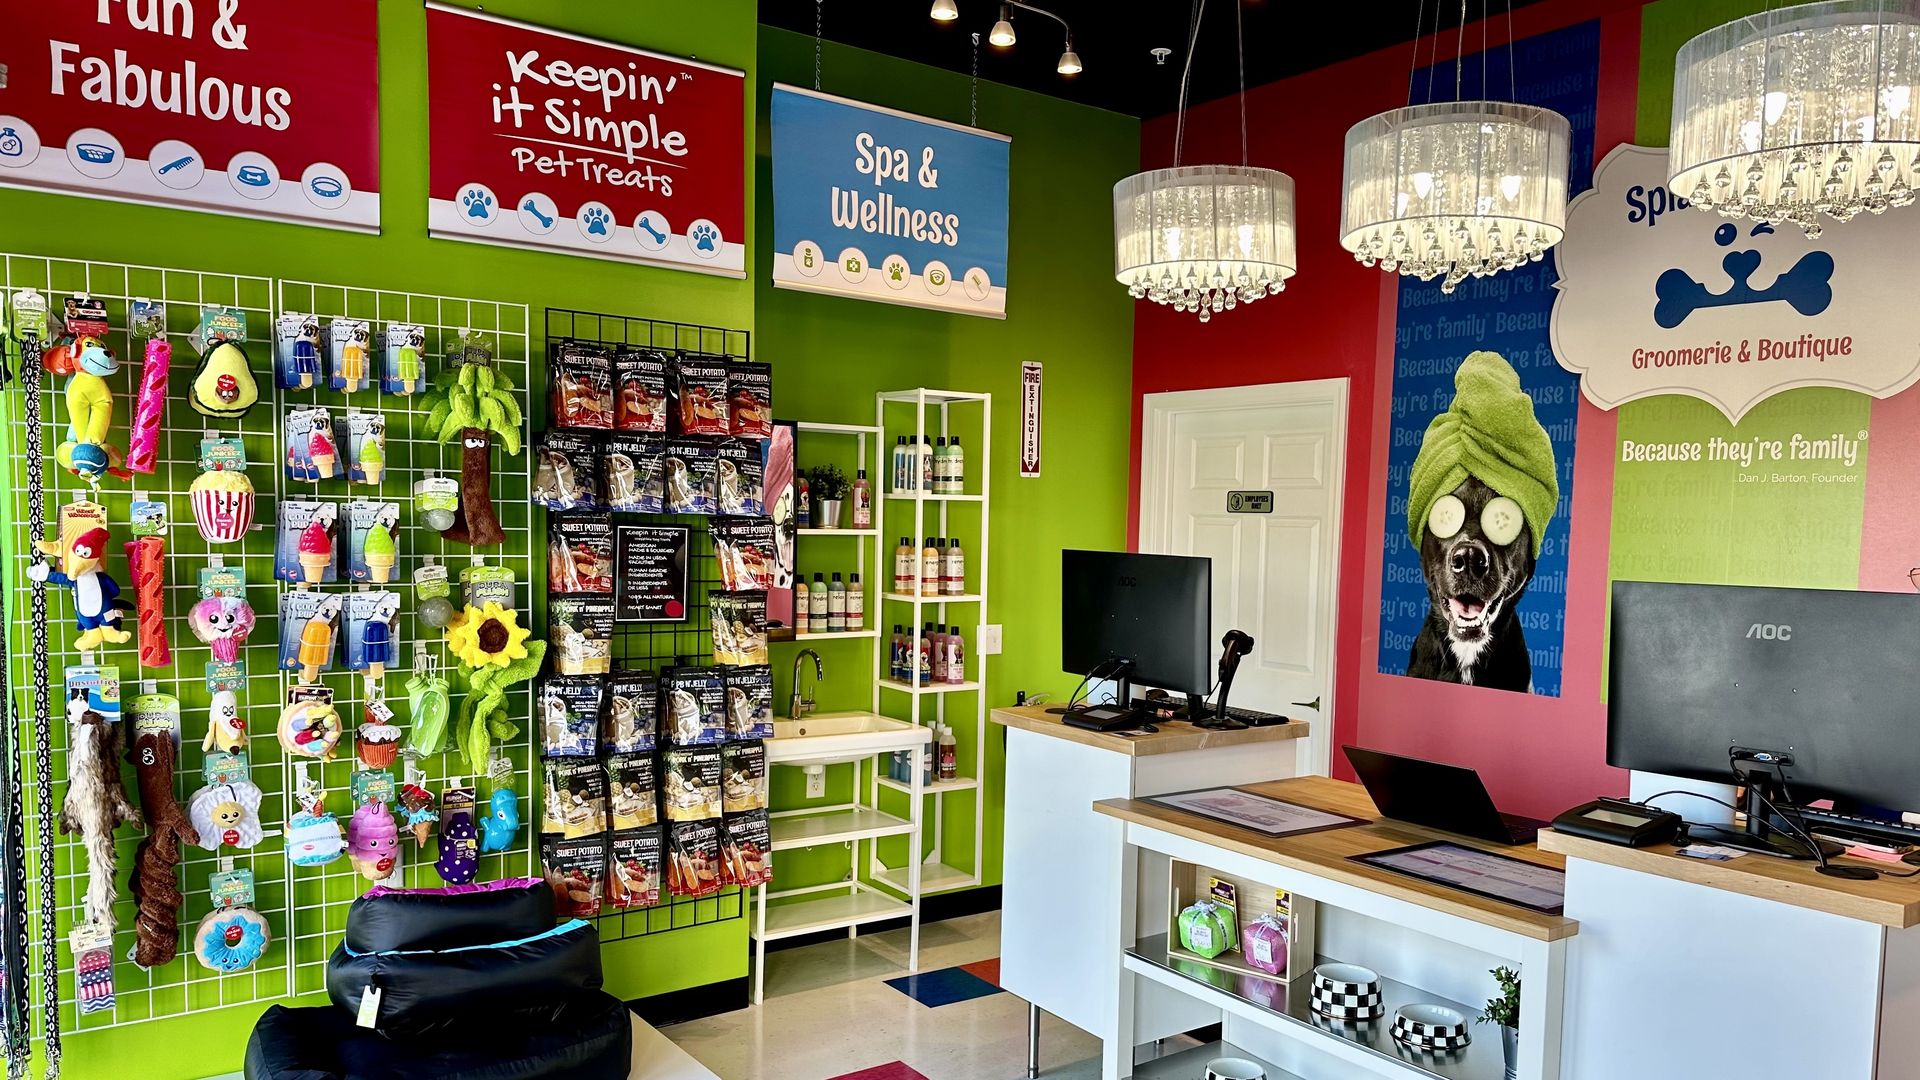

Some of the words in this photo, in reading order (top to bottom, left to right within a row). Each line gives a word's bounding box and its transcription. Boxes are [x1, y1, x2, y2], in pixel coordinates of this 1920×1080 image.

[212, 0, 249, 50] &
[50, 39, 292, 131] Fabulous
[493, 83, 534, 128] it
[545, 98, 688, 164] Simple
[855, 132, 909, 186] Spa
[918, 146, 938, 188] &
[511, 147, 574, 177] Pet
[576, 157, 673, 197] Treats
[831, 186, 960, 247] Wellness
[1631, 340, 1733, 369] Groomerie
[1737, 339, 1751, 363] &
[1757, 333, 1853, 362] Boutique
[564, 355, 586, 364] SWEET
[637, 362, 663, 371] POTATO
[702, 368, 726, 377] POTATO
[1025, 372, 1040, 384] FIRE
[1622, 440, 1702, 462] Because
[1708, 436, 1782, 467] they're
[1771, 473, 1809, 484] Barton,
[1811, 473, 1858, 483] Founder
[562, 523, 584, 532] SWEET
[1745, 622, 1792, 641] AOC
[746, 819, 767, 830] POTATO
[613, 840, 634, 849] SWEET
[634, 837, 659, 847] POTATO
[556, 847, 577, 858] SWEET
[578, 846, 603, 856] POTATO
